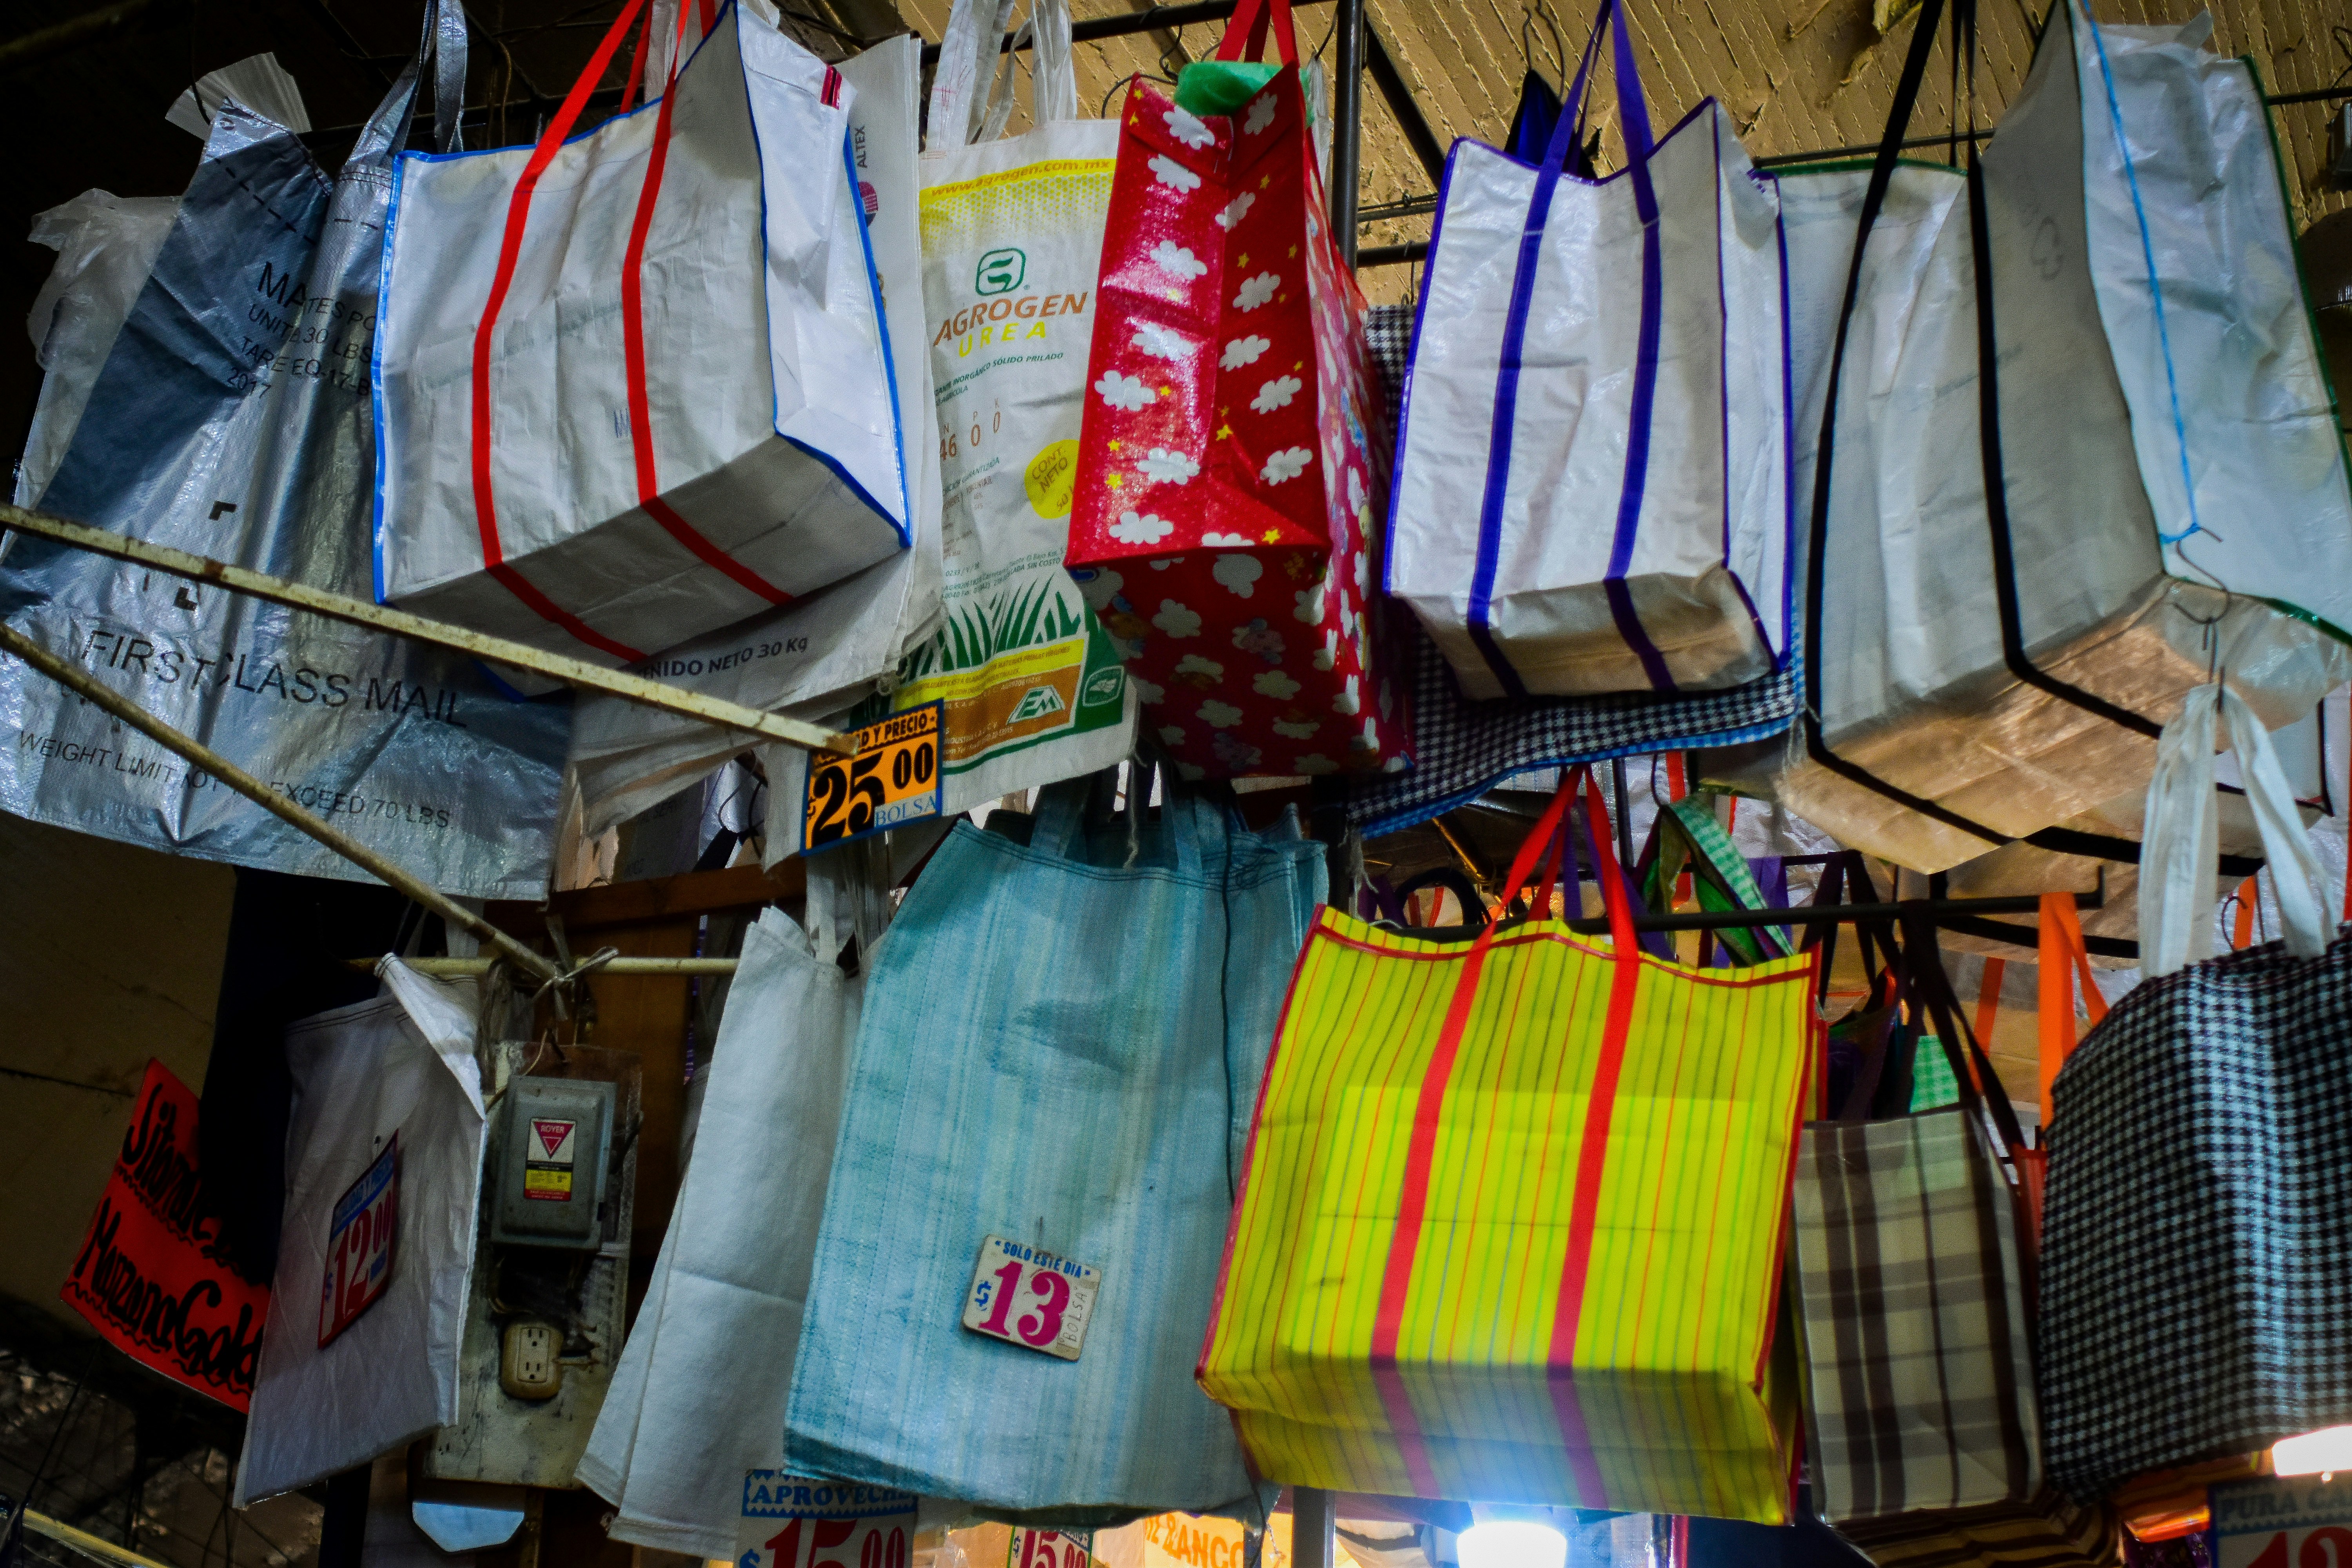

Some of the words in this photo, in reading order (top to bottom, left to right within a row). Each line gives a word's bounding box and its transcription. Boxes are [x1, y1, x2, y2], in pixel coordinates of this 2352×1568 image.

[855, 125, 867, 169] ALTEX
[931, 160, 1110, 196] www.agrogen.com.mx
[933, 291, 1088, 347] AGROGEN
[332, 338, 373, 363] LBS
[959, 321, 1047, 357] UREA
[708, 647, 753, 674] NETO
[757, 641, 783, 659] 30
[785, 636, 808, 653] Kg
[82, 630, 216, 690] FIRST
[366, 677, 466, 728] MAIL
[884, 713, 927, 740] PRECIO
[19, 731, 112, 766] WEIGHT
[115, 753, 177, 782] LIMIT
[374, 799, 399, 819] 70
[876, 795, 936, 825] BOLSA
[1002, 1241, 1033, 1261] SOLO
[1033, 1253, 1062, 1271] ESTE
[1063, 1260, 1082, 1278] DIA
[1064, 1290, 1088, 1343] BOLSA
